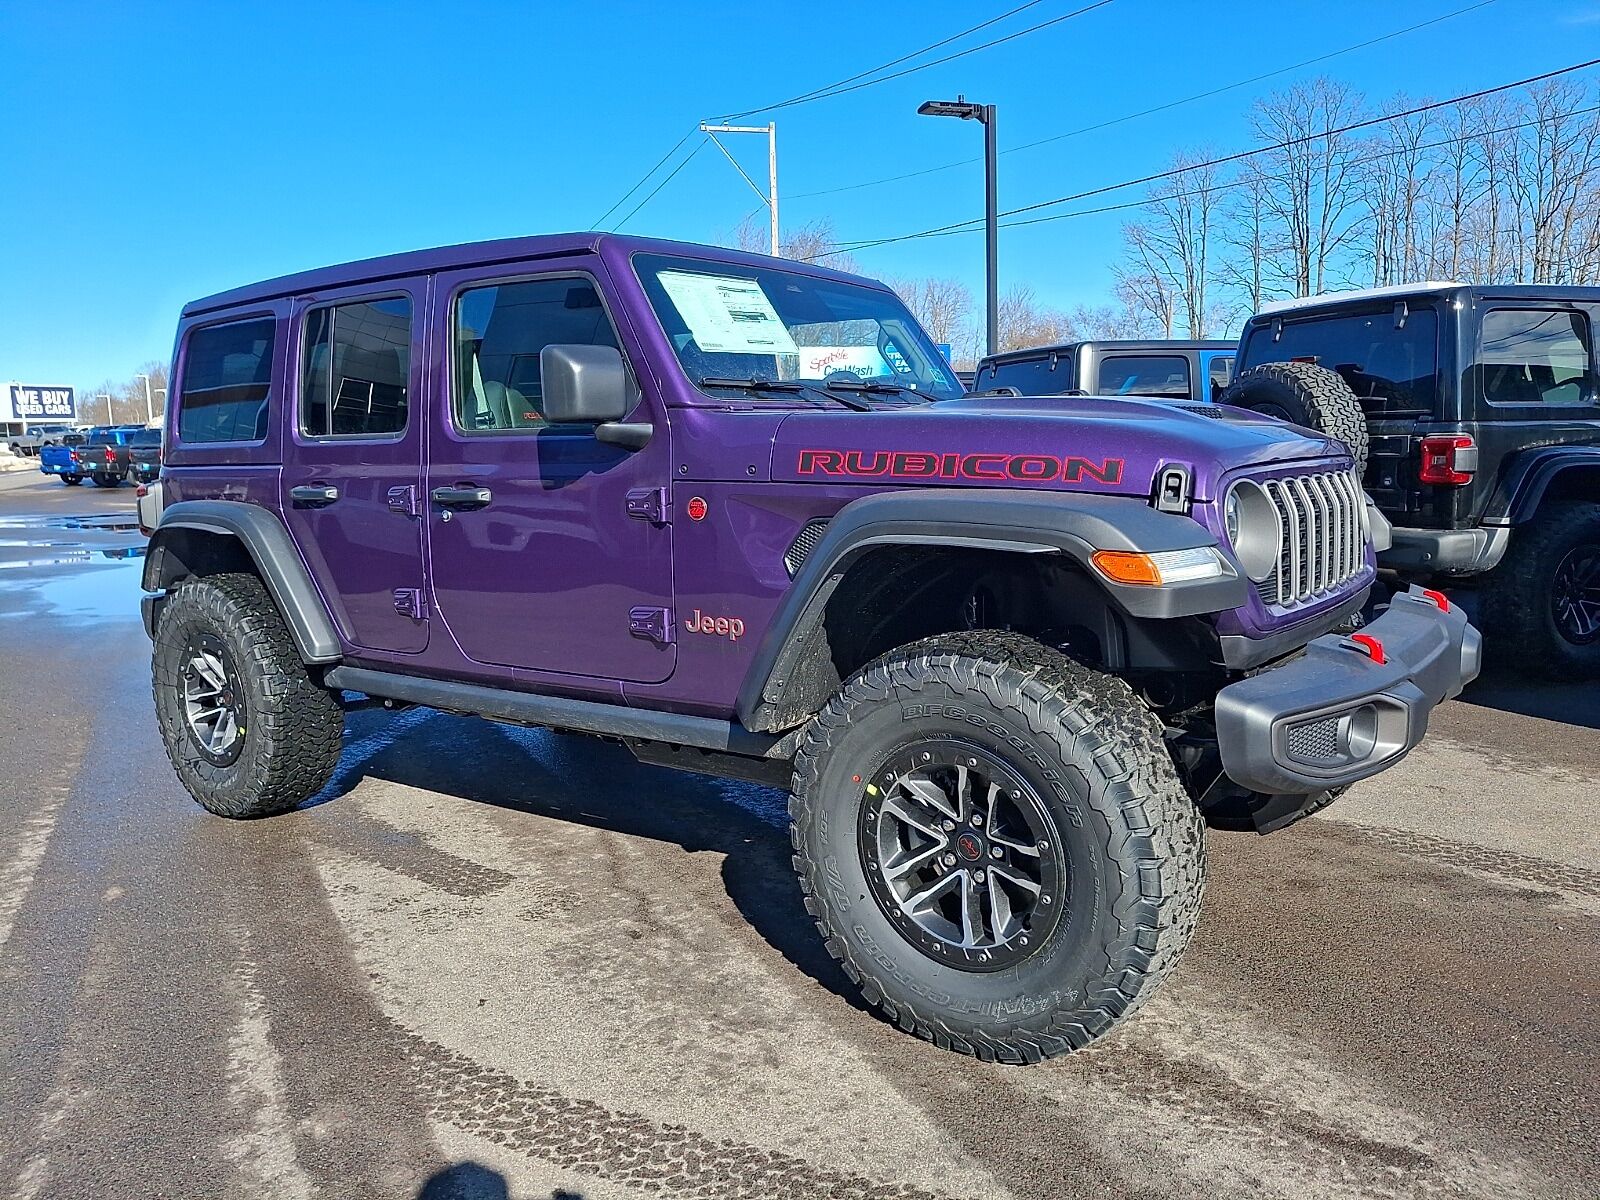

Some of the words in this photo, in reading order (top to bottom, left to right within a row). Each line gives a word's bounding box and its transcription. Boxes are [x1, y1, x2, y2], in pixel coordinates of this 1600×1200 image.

[844, 365, 873, 376] Wash
[15, 390, 39, 404] WE
[41, 390, 70, 404] BUY
[16, 404, 43, 415] USED
[44, 404, 72, 415] CARS
[798, 450, 1124, 484] RUBICON
[685, 609, 745, 641] Jeep
